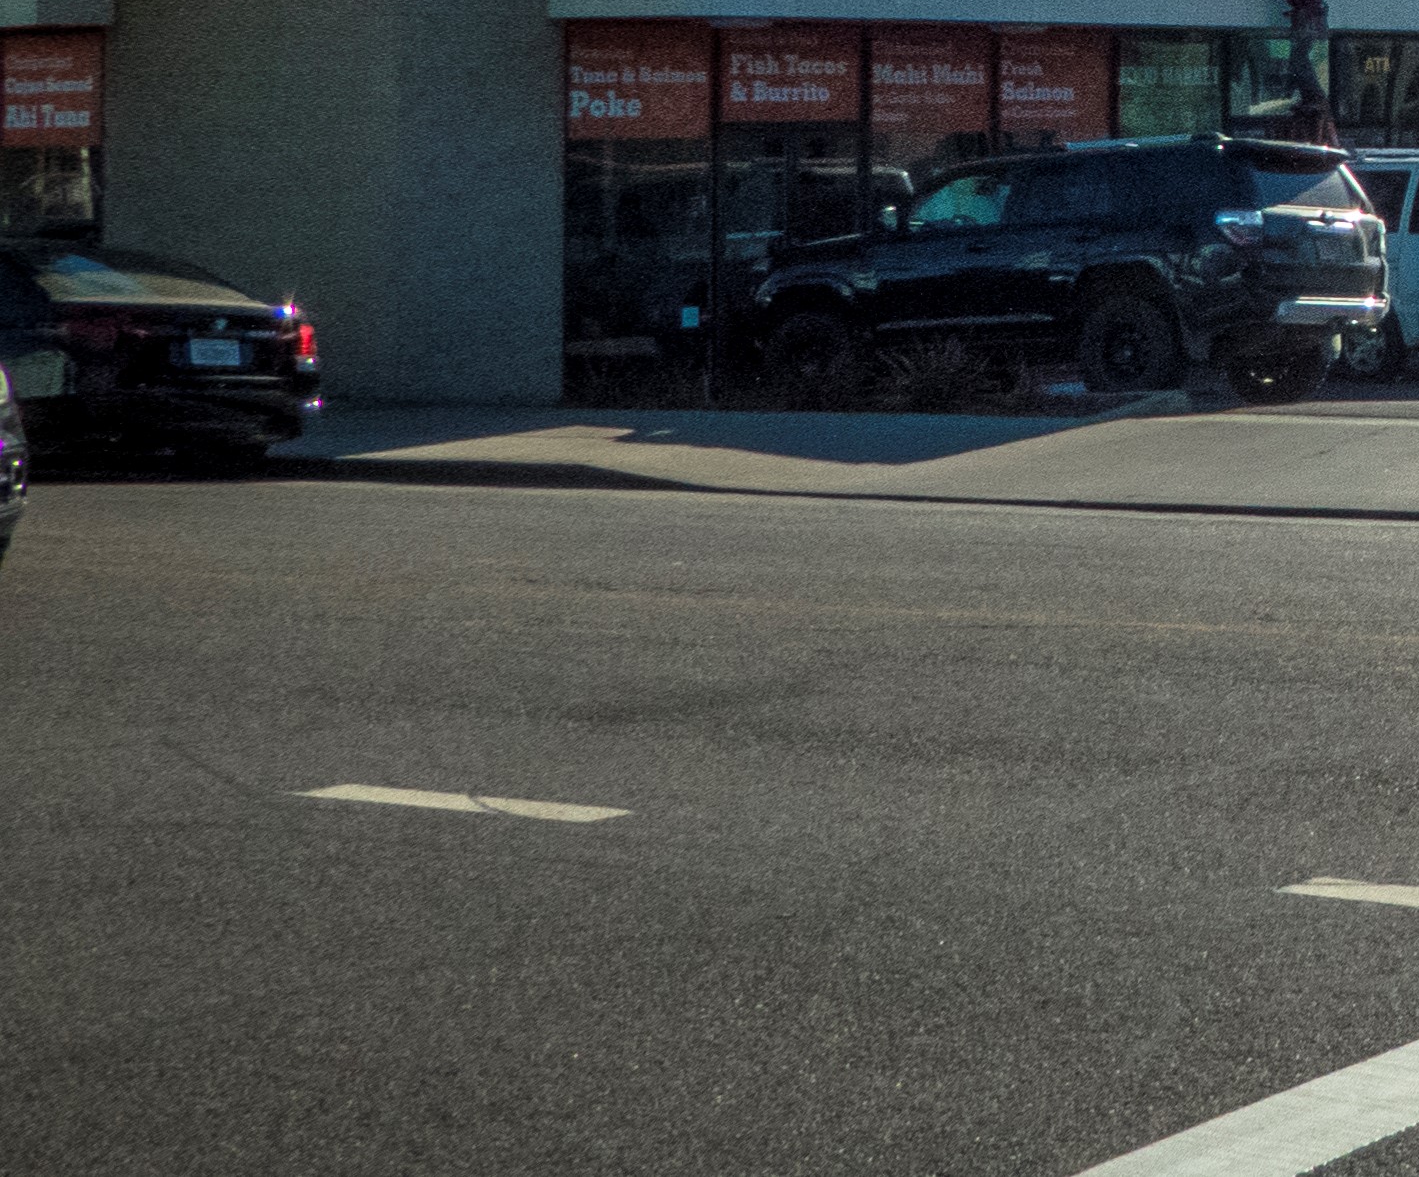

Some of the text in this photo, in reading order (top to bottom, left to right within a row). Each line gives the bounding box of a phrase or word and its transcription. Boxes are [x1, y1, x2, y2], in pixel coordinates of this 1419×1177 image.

[731, 53, 848, 75] Fish Tacos
[932, 63, 985, 85] Mahi
[730, 79, 830, 103] & Burrito
[1002, 81, 1075, 102] Salmon
[569, 89, 642, 118] Poke
